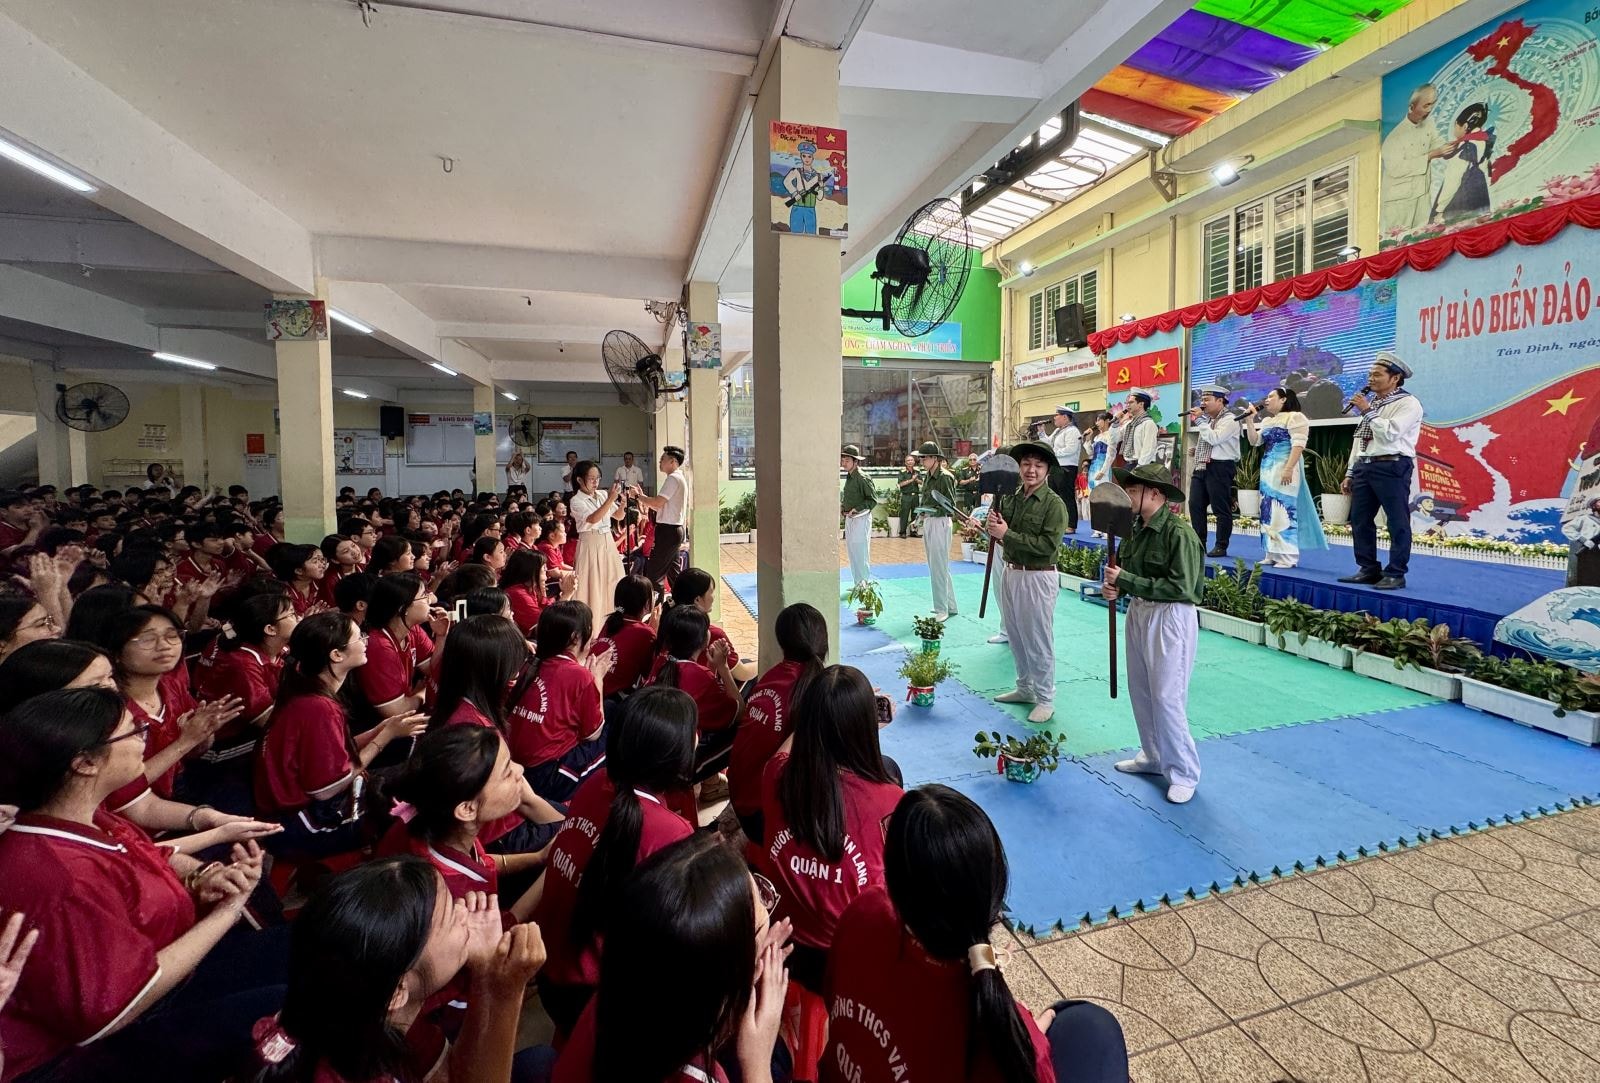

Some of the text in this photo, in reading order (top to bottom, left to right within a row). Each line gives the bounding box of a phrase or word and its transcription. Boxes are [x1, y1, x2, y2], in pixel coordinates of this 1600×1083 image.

[1584, 7, 1600, 24] Bá
[1419, 261, 1591, 350] TỰ HÀO BIỂN ĐẢO
[527, 710, 545, 724] ĐỊNH
[762, 714, 769, 725] 1
[774, 708, 783, 732] LANG
[576, 816, 597, 838] THCS
[552, 847, 584, 889] QUẬN 1
[790, 855, 843, 884] QUẬN 1
[851, 852, 868, 887] LANG
[857, 1002, 891, 1049] THCS
[887, 1045, 911, 1083] VĂ
